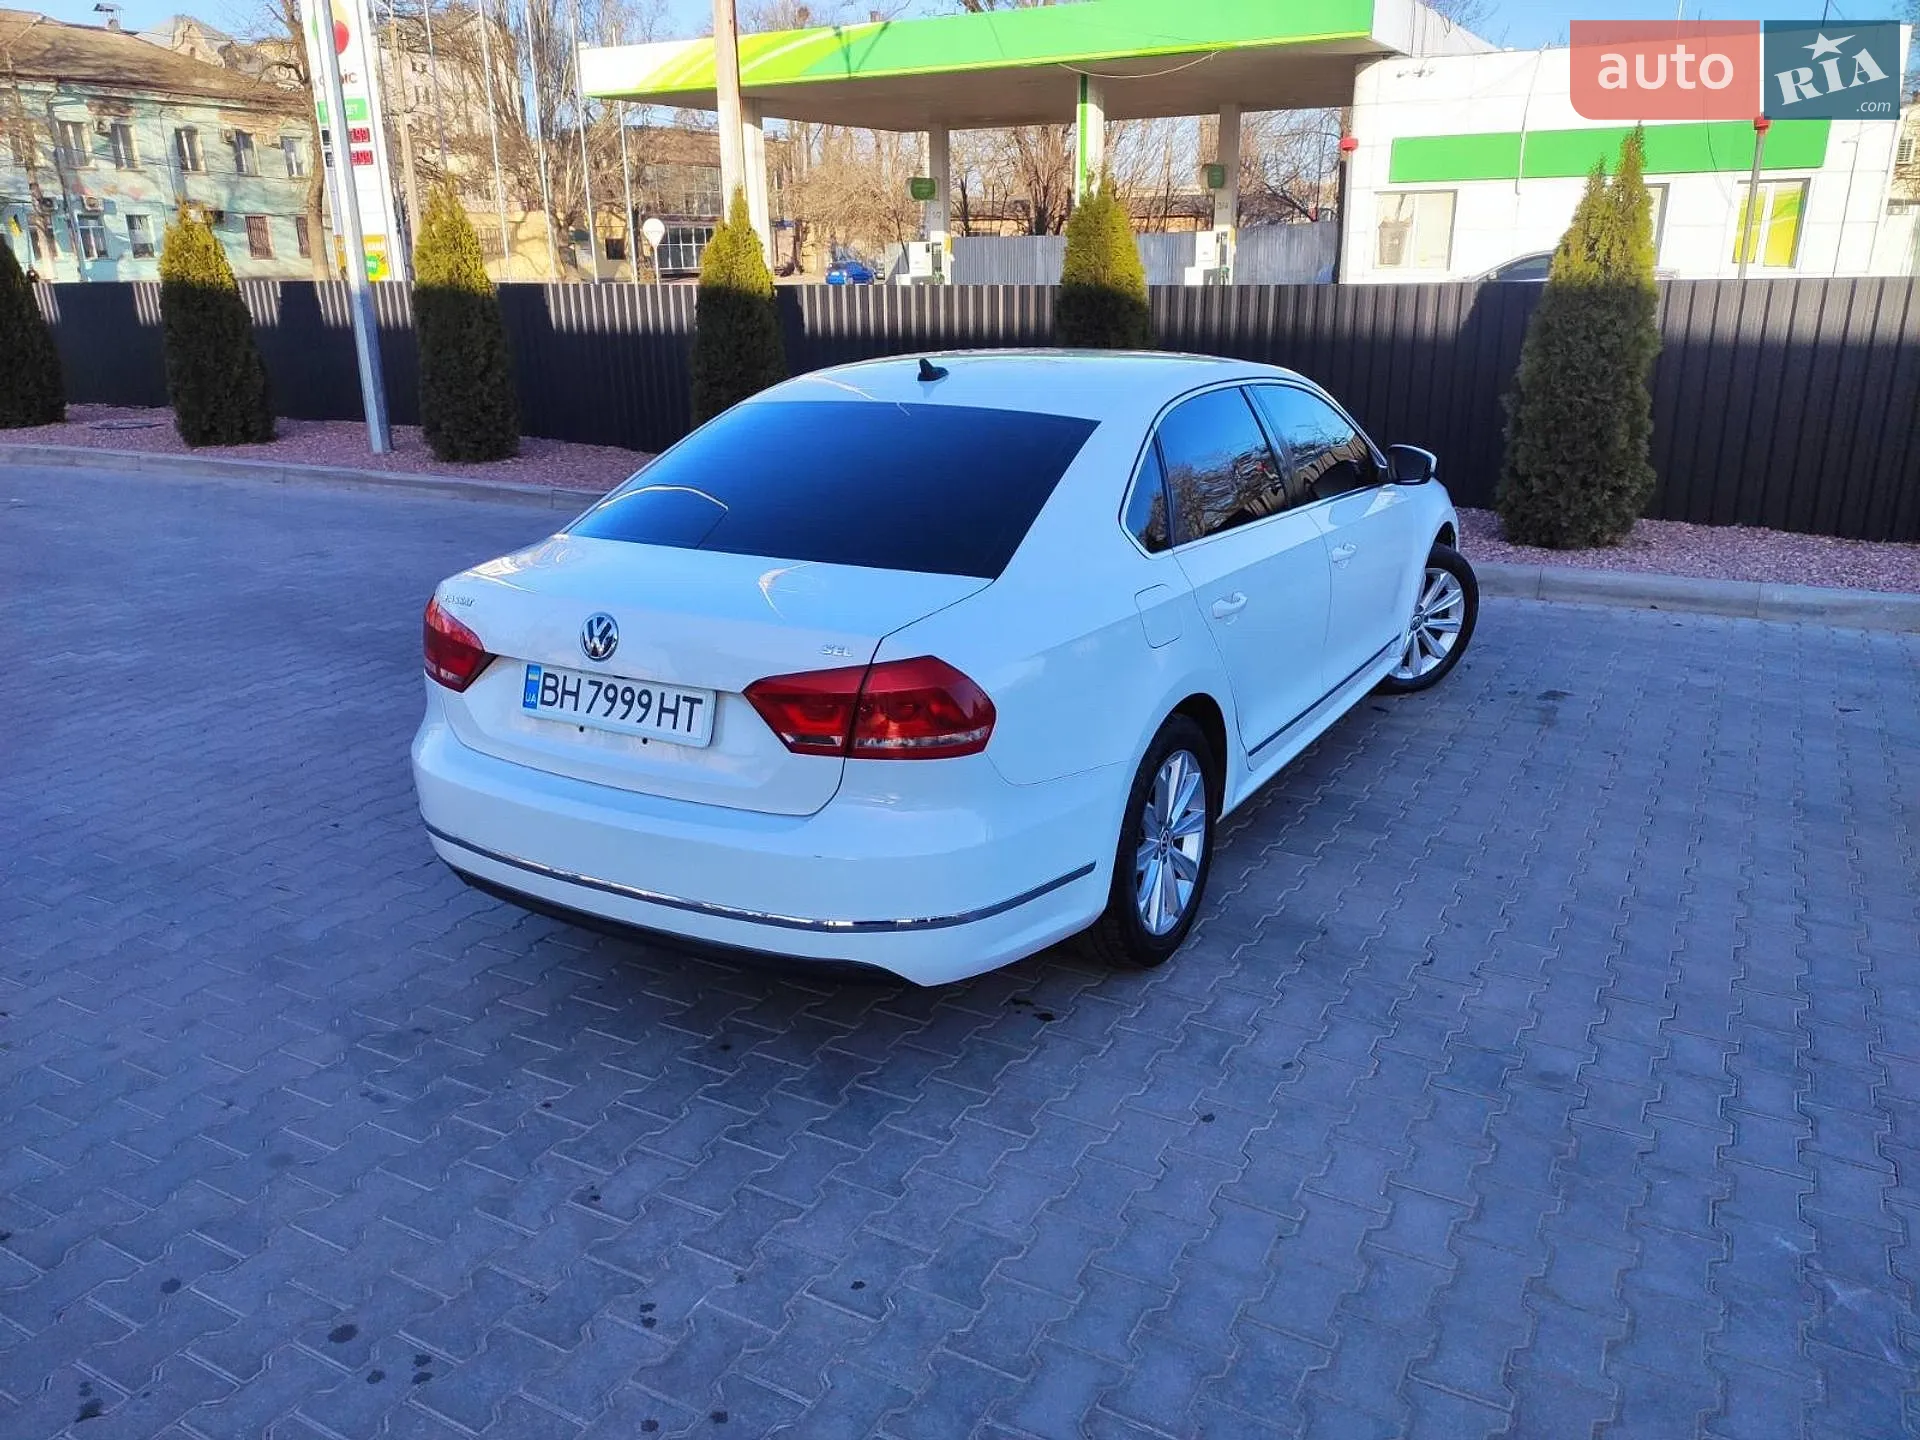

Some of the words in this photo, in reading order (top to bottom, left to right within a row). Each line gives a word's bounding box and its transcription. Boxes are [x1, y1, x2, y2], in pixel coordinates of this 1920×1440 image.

[822, 643, 854, 658] SEL
[525, 692, 537, 704] UA
[540, 672, 581, 712] BH
[586, 680, 653, 723] 7999
[656, 692, 704, 733] HT
